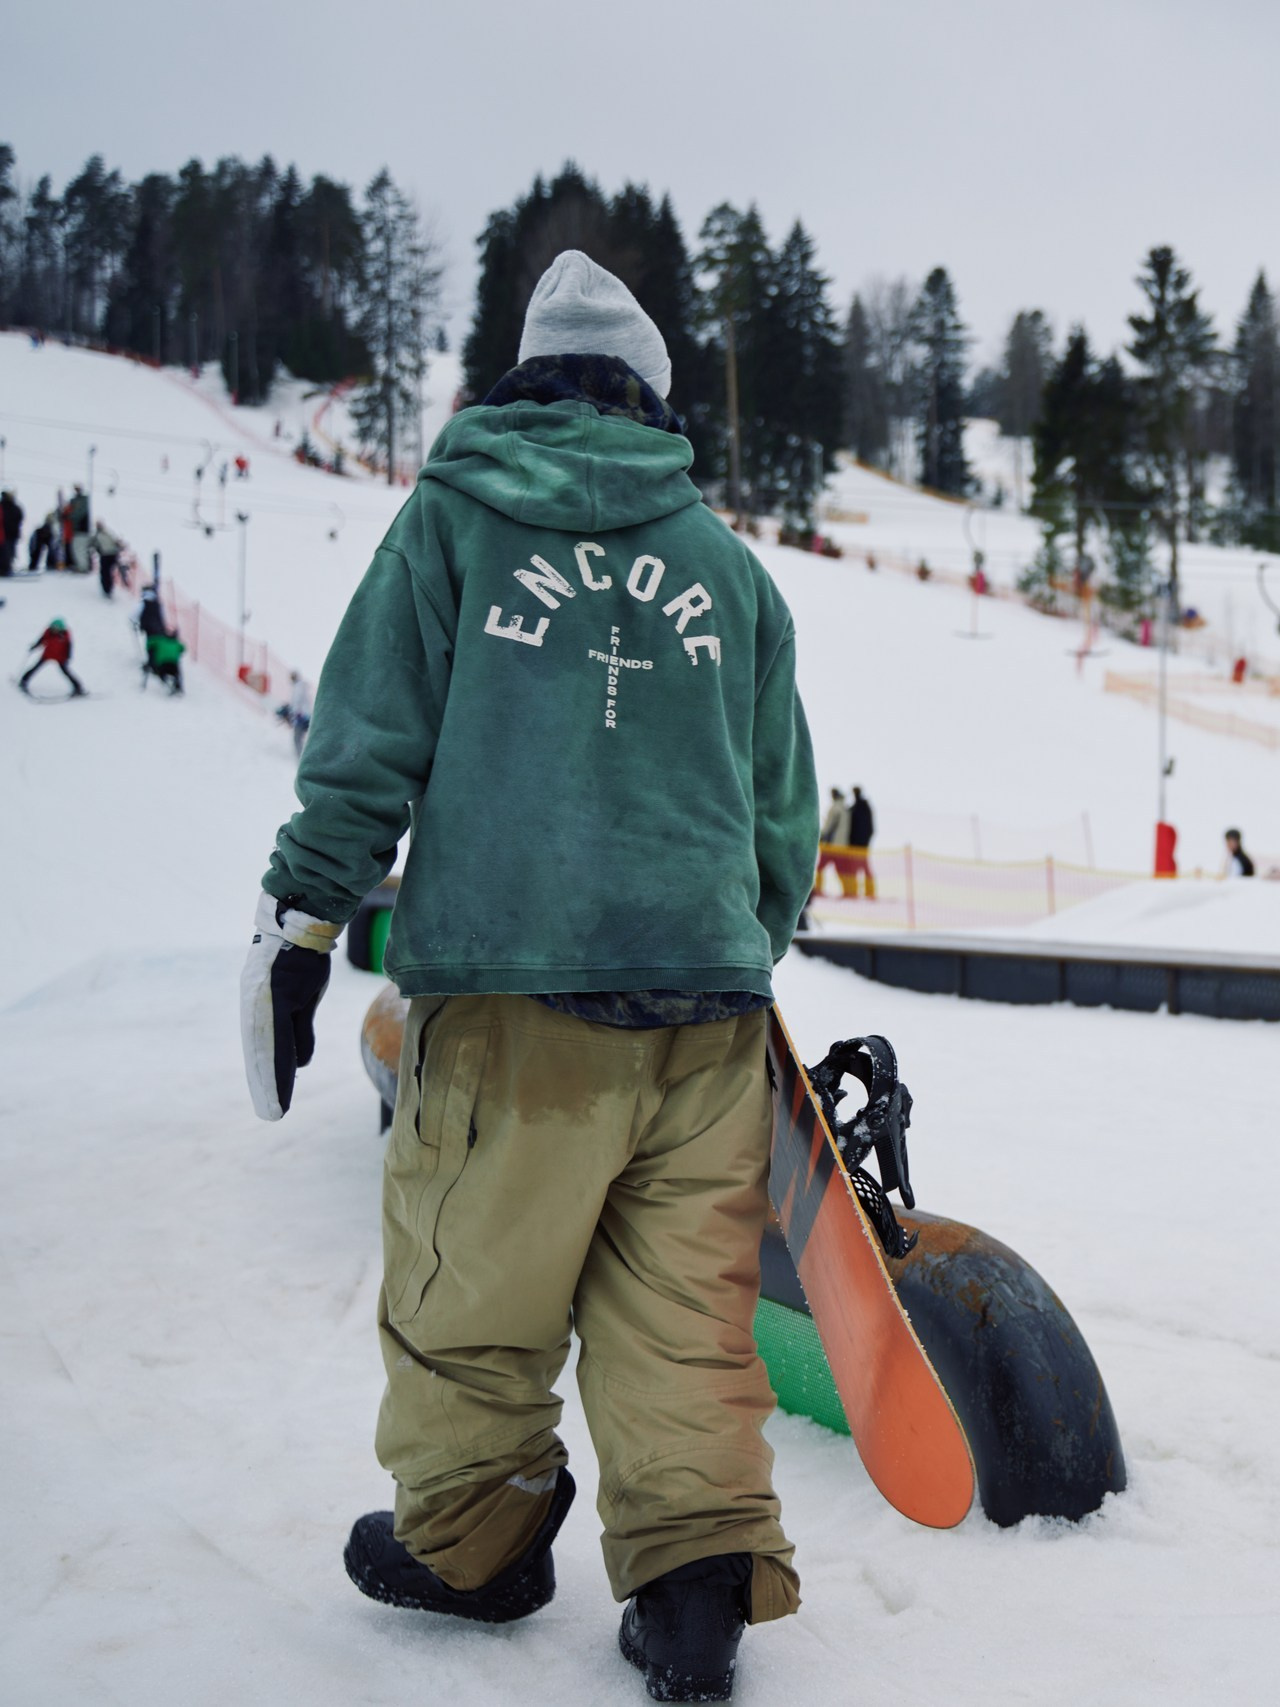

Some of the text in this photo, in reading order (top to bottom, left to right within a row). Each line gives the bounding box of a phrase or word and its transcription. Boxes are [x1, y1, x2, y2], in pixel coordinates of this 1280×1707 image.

[483, 541, 721, 667] ENCORE
[588, 648, 654, 670] FRIENDS
[605, 625, 620, 729] FRIENDS FOR
